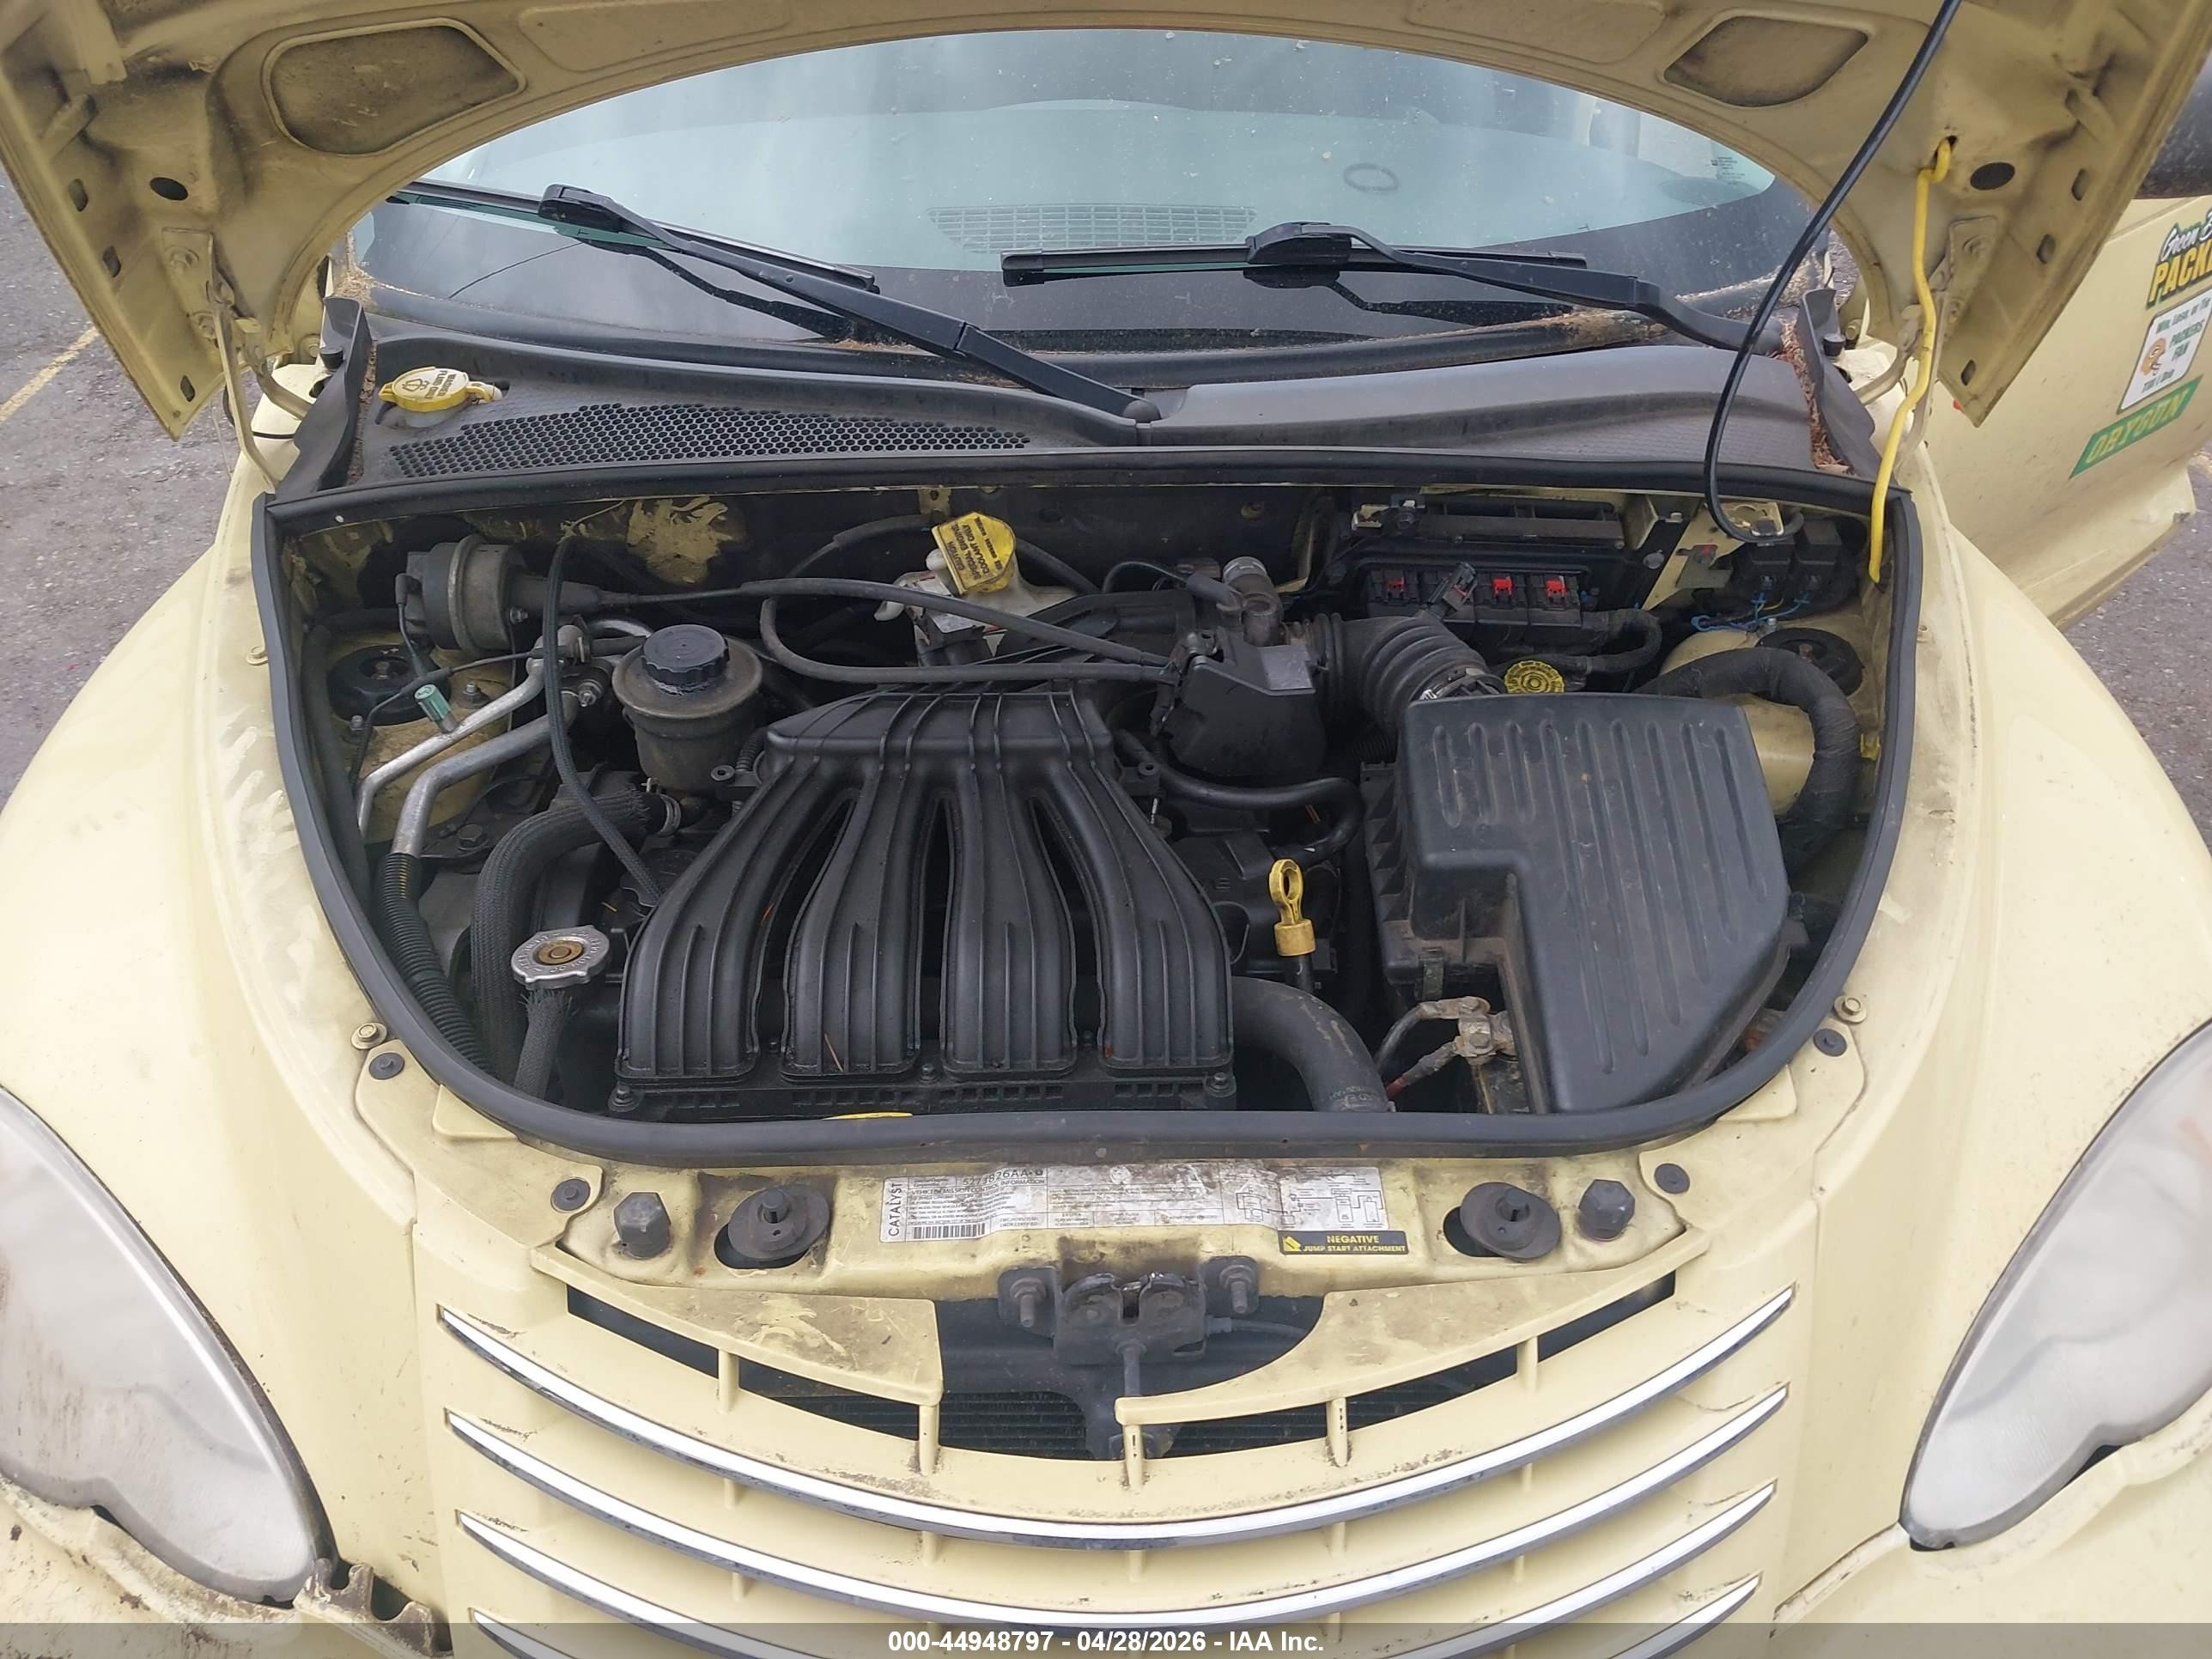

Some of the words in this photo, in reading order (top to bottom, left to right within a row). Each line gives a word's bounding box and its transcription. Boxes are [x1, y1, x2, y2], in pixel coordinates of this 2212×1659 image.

[947, 541, 964, 571] CAUTION
[964, 550, 981, 580] SPECIAL
[970, 543, 989, 574] COOLANT
[888, 1182, 902, 1237] CATALYST
[1327, 1235, 1380, 1243] NEGATIVE
